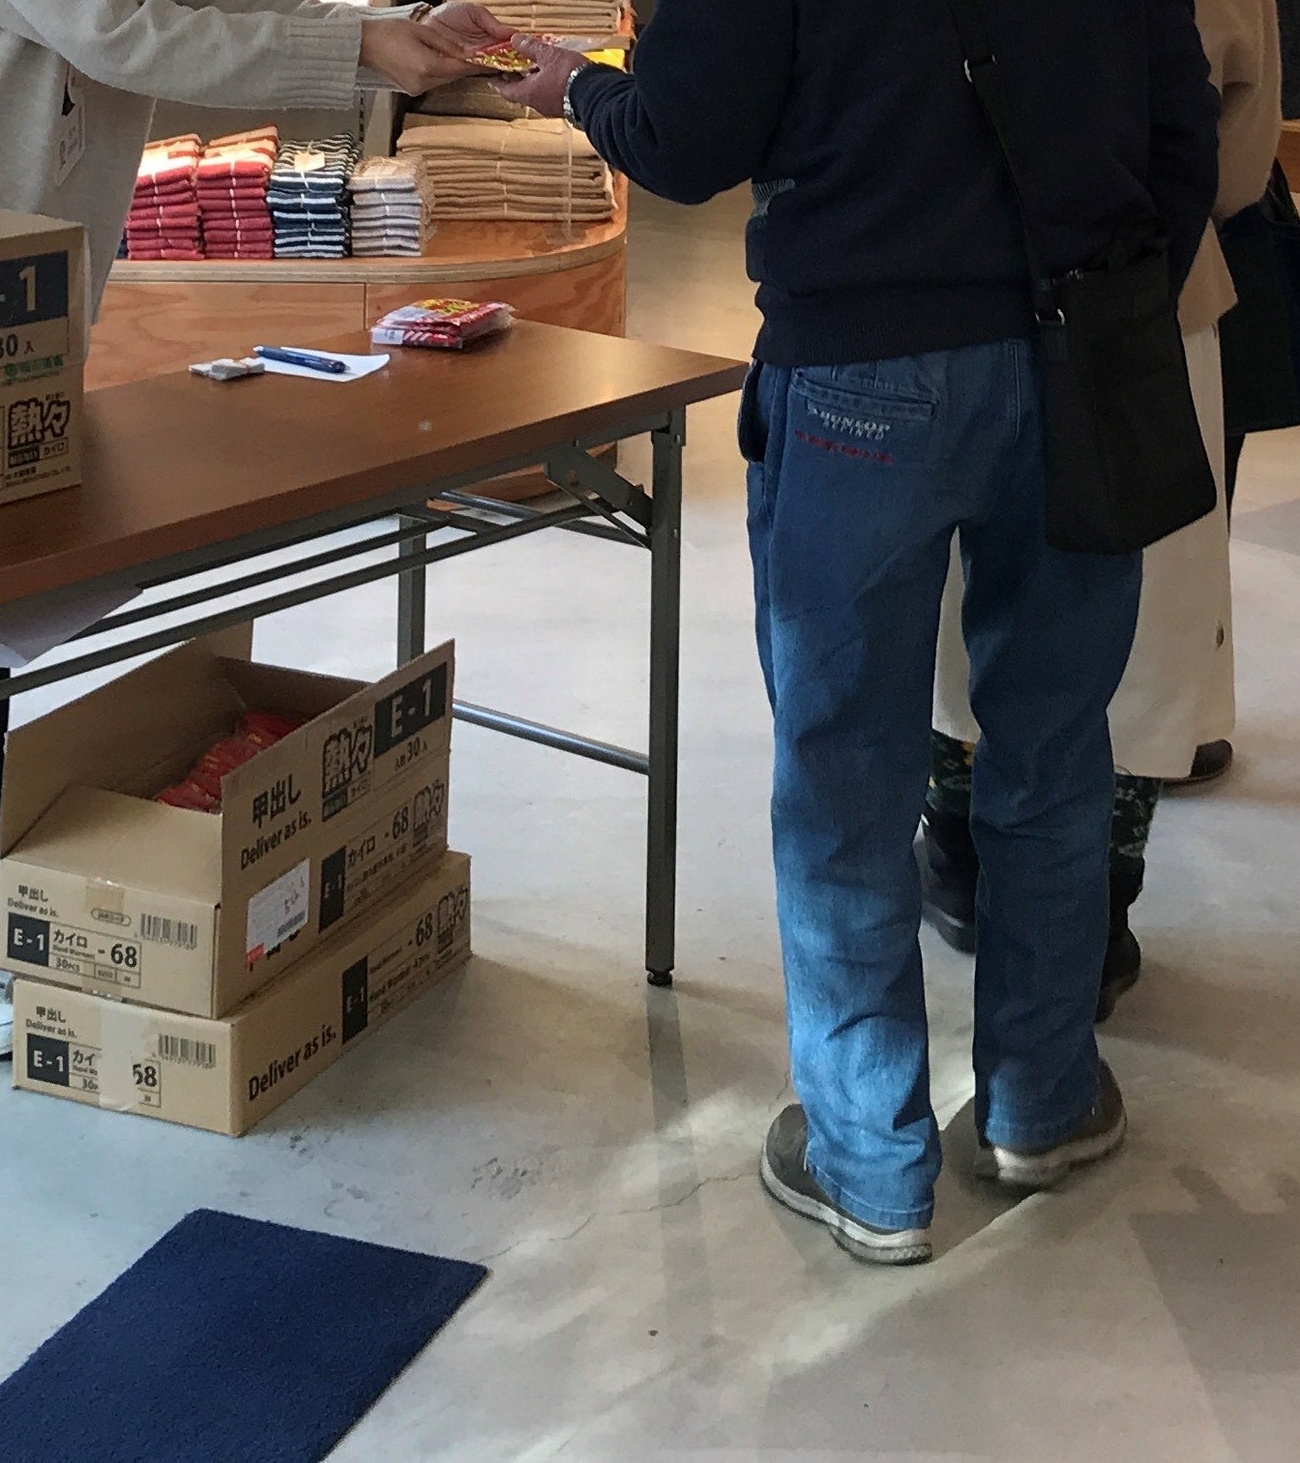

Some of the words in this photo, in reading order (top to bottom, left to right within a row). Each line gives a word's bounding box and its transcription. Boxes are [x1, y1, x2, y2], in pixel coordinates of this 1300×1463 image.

[253, 774, 301, 828] 甲出し
[241, 829, 282, 870] Deliver
[284, 820, 297, 838] as
[7, 897, 38, 913] Deliver
[18, 884, 49, 903] 甲出し
[13, 928, 45, 952] E-1
[53, 929, 88, 949] カイロ
[36, 1005, 67, 1023] 甲出し
[26, 1018, 56, 1035] Deliver
[33, 1050, 64, 1072] E-1
[72, 1049, 96, 1067] カイ
[249, 1048, 301, 1101] Deliver
[303, 1037, 319, 1061] as
